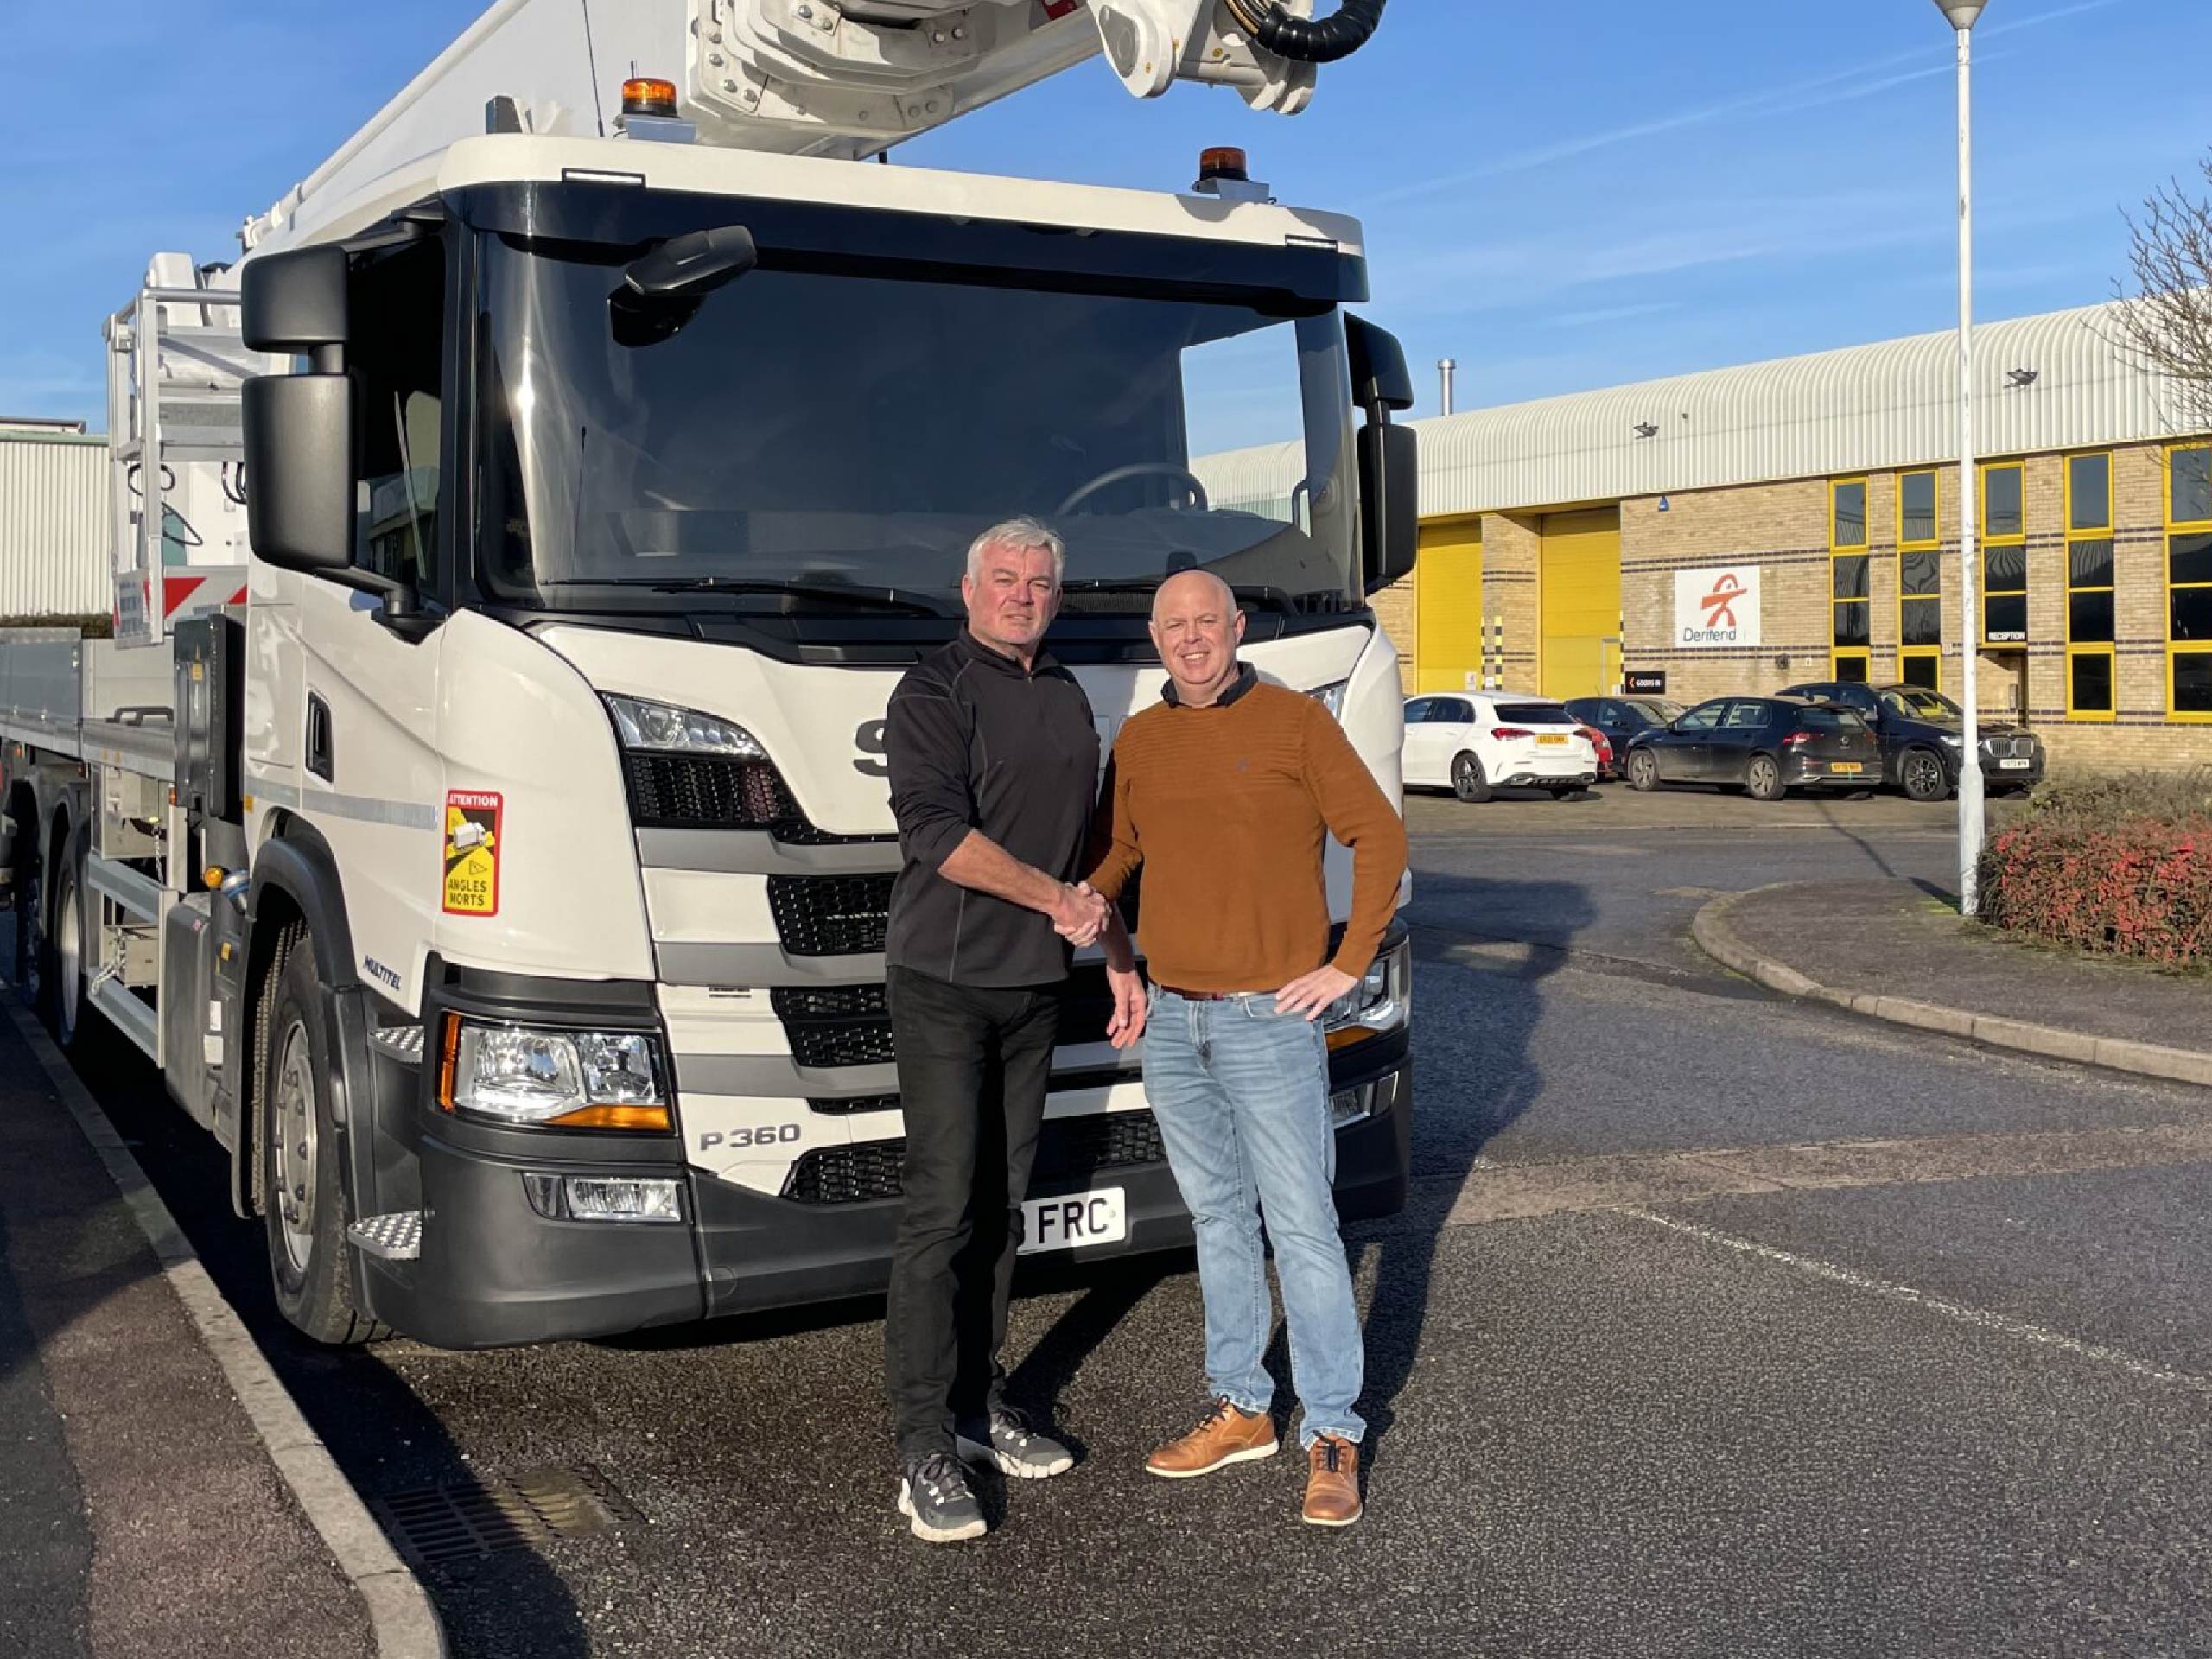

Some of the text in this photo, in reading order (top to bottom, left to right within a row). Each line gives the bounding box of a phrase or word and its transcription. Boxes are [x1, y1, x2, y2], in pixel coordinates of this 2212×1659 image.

[448, 794, 499, 807] ATTENTION
[448, 878, 487, 893] ANGLES
[449, 893, 485, 906] MORTS
[363, 955, 402, 991] MULTITEL
[699, 1123, 801, 1151] P 360
[1038, 1198, 1108, 1243] FRC
